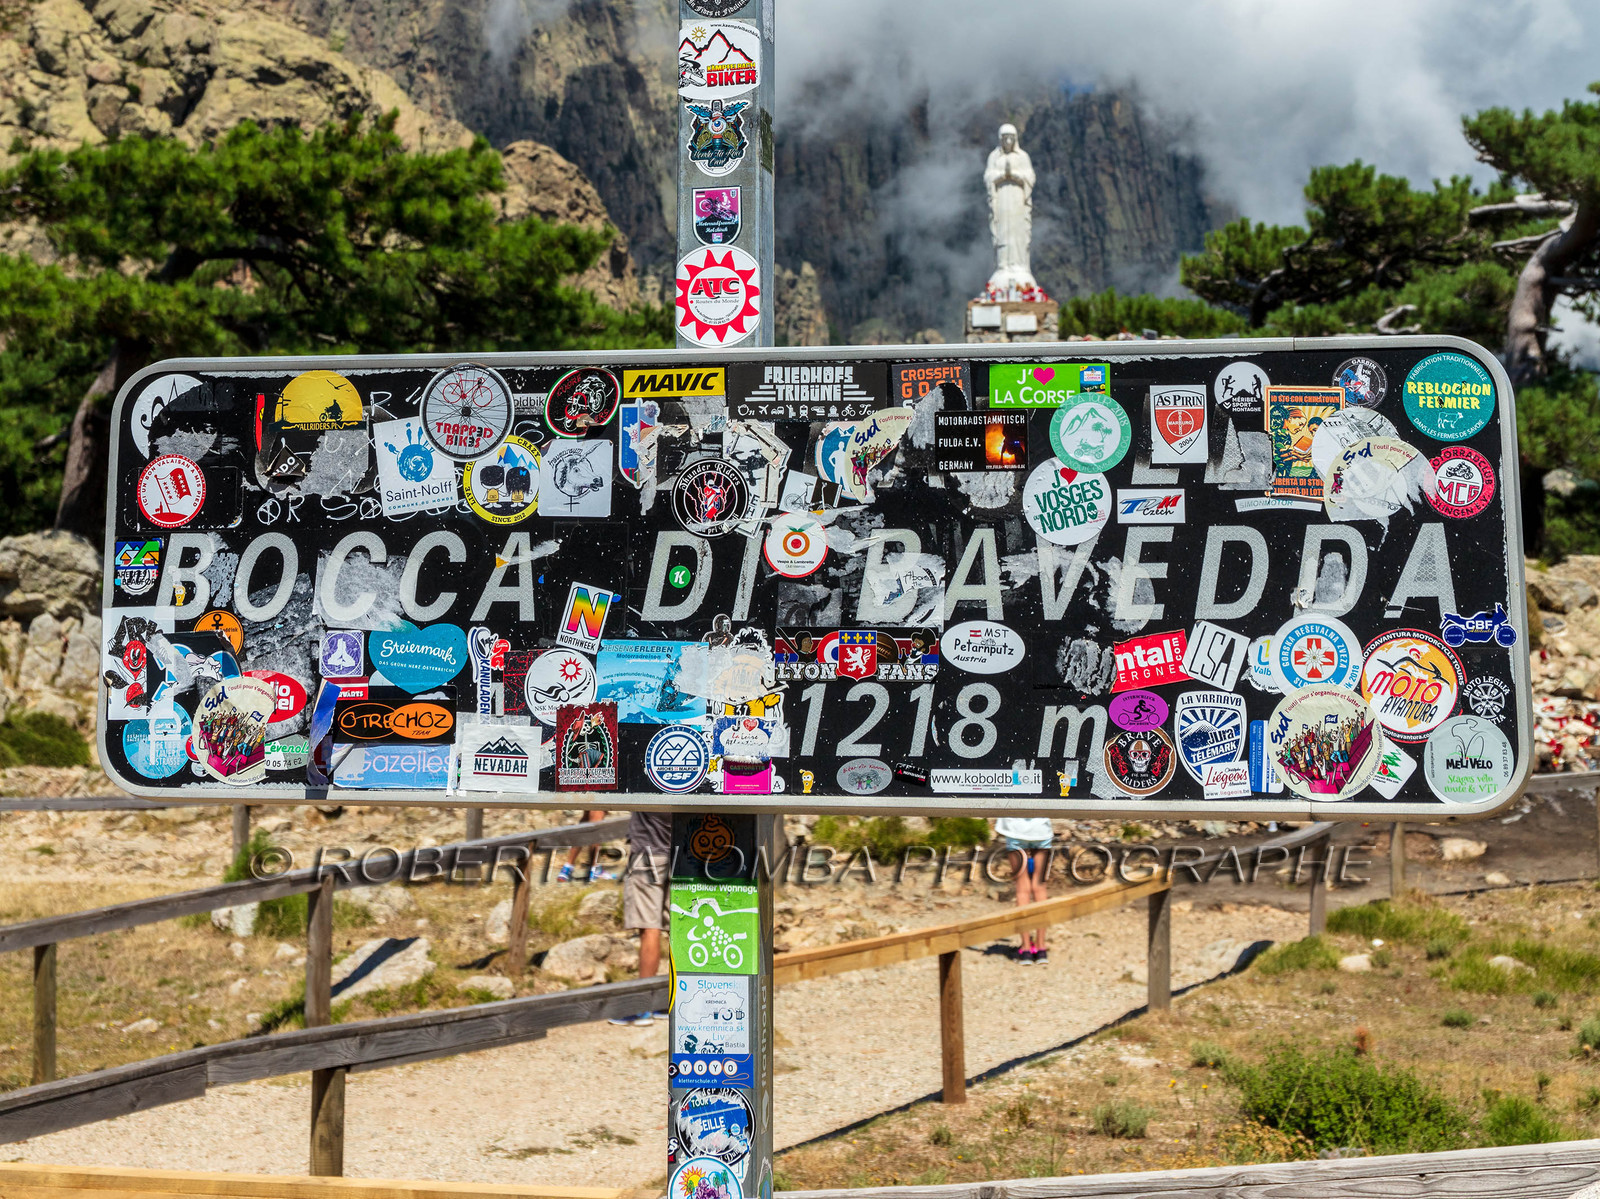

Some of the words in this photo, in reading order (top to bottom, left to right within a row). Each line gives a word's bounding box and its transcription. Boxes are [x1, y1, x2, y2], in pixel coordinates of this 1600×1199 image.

[706, 70, 757, 87] BIKER
[690, 278, 740, 299] ATC
[901, 367, 962, 382] CROSSFIT
[1409, 356, 1442, 381] FABRICATION
[1442, 354, 1488, 382] TRADITIONNELLE
[629, 372, 720, 393] MAVIC
[1406, 382, 1491, 396] REBLOCHON
[995, 390, 1015, 404] LA
[1172, 394, 1203, 407] PIRIN
[1304, 396, 1340, 404] CHINATOWN
[938, 415, 1025, 426] MOTORRADSTAMMTISCH
[1110, 402, 1129, 428] 2018
[1413, 418, 1428, 431] DANS
[1427, 428, 1437, 436] LES
[1437, 430, 1459, 439] FERMES
[1459, 430, 1468, 438] DE
[1467, 419, 1485, 436] SAVOIE
[517, 438, 541, 457] CRAZY
[939, 438, 964, 448] FULDA
[1178, 437, 1193, 449] 2004
[145, 467, 156, 481] BON
[157, 459, 191, 469] VALAISAN
[939, 460, 974, 471] GERMANY
[680, 464, 712, 491] Thunder
[715, 464, 741, 487] Riders
[386, 481, 453, 503] Saint-Nolff
[1034, 479, 1104, 513] VOSGES
[1438, 479, 1481, 505] MCG
[1120, 494, 1183, 515] TDM
[1142, 504, 1175, 516] Czech
[514, 512, 526, 522] 2012
[1039, 503, 1089, 534] NORD
[155, 531, 536, 623] BOCCA
[641, 531, 765, 622] DI
[856, 523, 1459, 622] BAVEDDA
[674, 570, 685, 584] K
[985, 629, 1009, 637] MST
[1466, 620, 1494, 630] CBF
[560, 634, 596, 651] NORTHWEEK
[954, 638, 1014, 655] Petarnputz
[1282, 637, 1295, 667] GORSKA
[1296, 624, 1339, 642] REŠEVALNA
[1337, 643, 1348, 669] ZVEZA
[380, 640, 457, 665] Steiermark
[953, 655, 987, 664] Austria
[1412, 632, 1455, 660] MOTORCYCLE
[1453, 659, 1465, 687] TOURS
[777, 663, 837, 681] LYON
[878, 664, 938, 681] FANS
[1350, 664, 1360, 681] 2018
[480, 659, 491, 715] KANULADEN
[1367, 670, 1443, 704] MOTO
[1463, 678, 1482, 697] MOTO
[205, 686, 230, 711] Sud
[1182, 695, 1194, 705] LA
[1271, 711, 1293, 745] Sud
[1310, 690, 1340, 698] s'organiser
[1380, 696, 1439, 724] AVANTURA
[800, 682, 1002, 759] 1218
[1037, 704, 1108, 759] m
[1119, 731, 1162, 748] BRAVE
[474, 758, 528, 773] NEVADAH
[1122, 774, 1158, 788] RIDERS
[1205, 767, 1248, 789] Liégeois
[1447, 775, 1475, 784] Stages
[1206, 789, 1250, 797] www.liegeois.be
[1444, 784, 1467, 793] route
[1479, 784, 1498, 793] VTT
